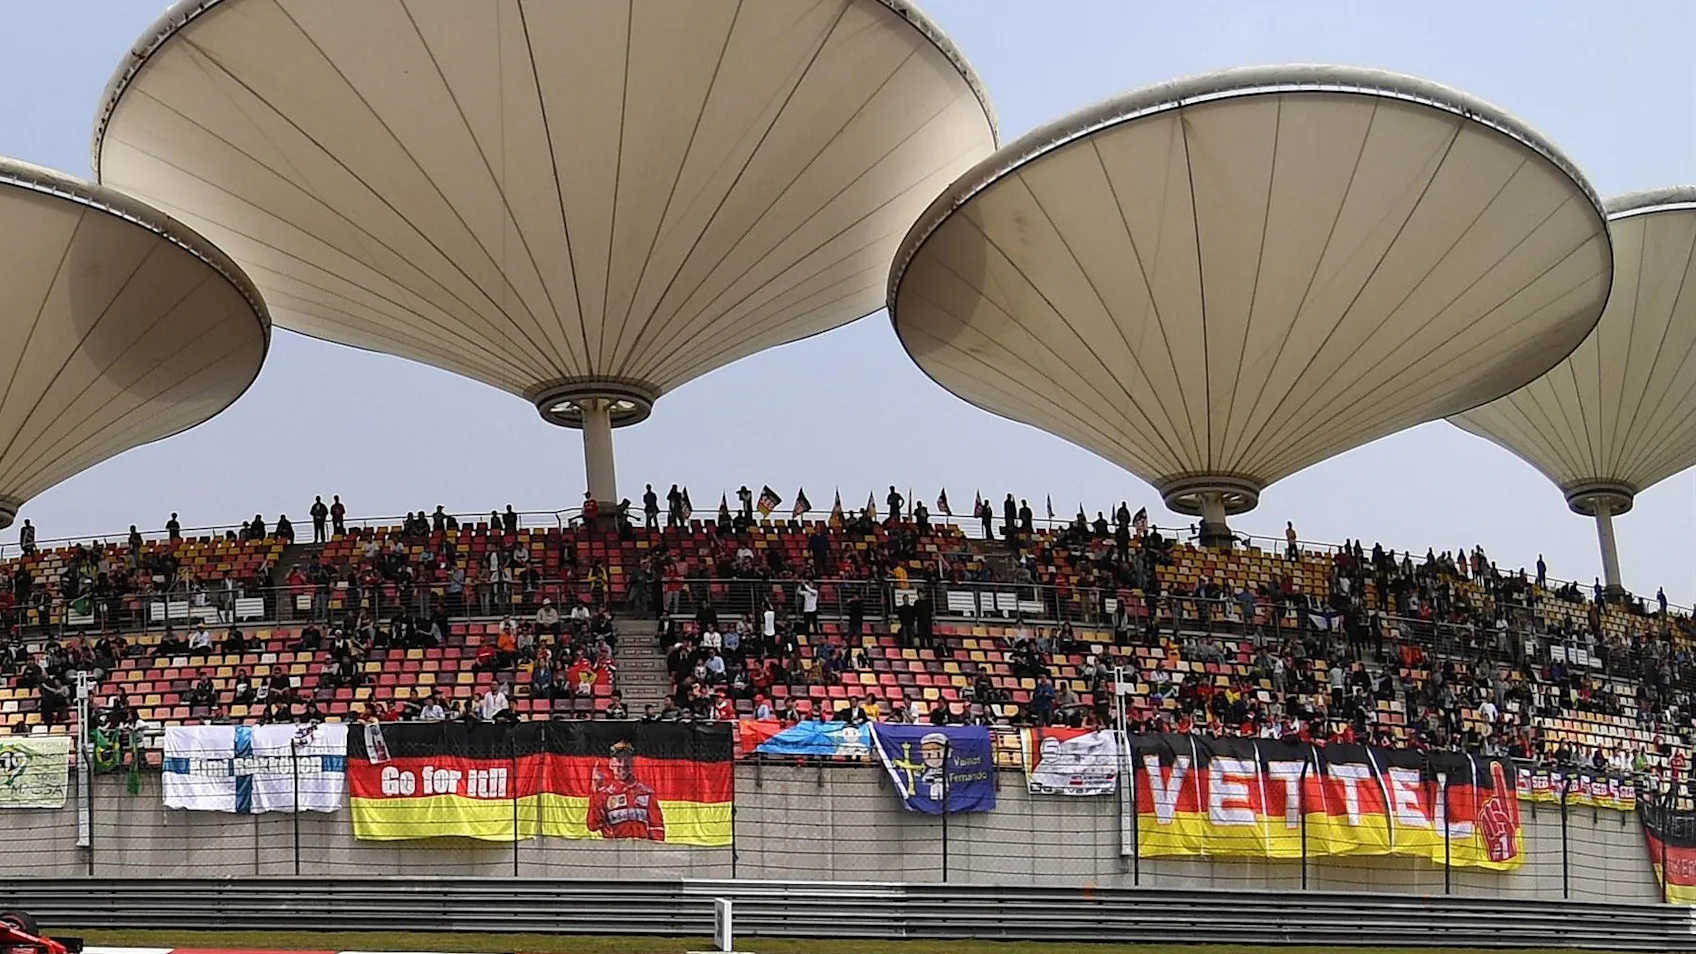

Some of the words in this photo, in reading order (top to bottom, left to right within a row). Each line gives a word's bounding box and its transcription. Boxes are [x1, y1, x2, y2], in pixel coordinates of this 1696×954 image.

[953, 756, 981, 767] Vamos
[381, 766, 415, 796] Go
[422, 766, 462, 794] for
[949, 771, 988, 783] Fernando
[1532, 775, 1548, 789] SEB
[1591, 782, 1607, 796] SEB
[1609, 778, 1620, 802] 5
[1619, 785, 1635, 798] SEB
[1142, 754, 1473, 839] VETTEL
